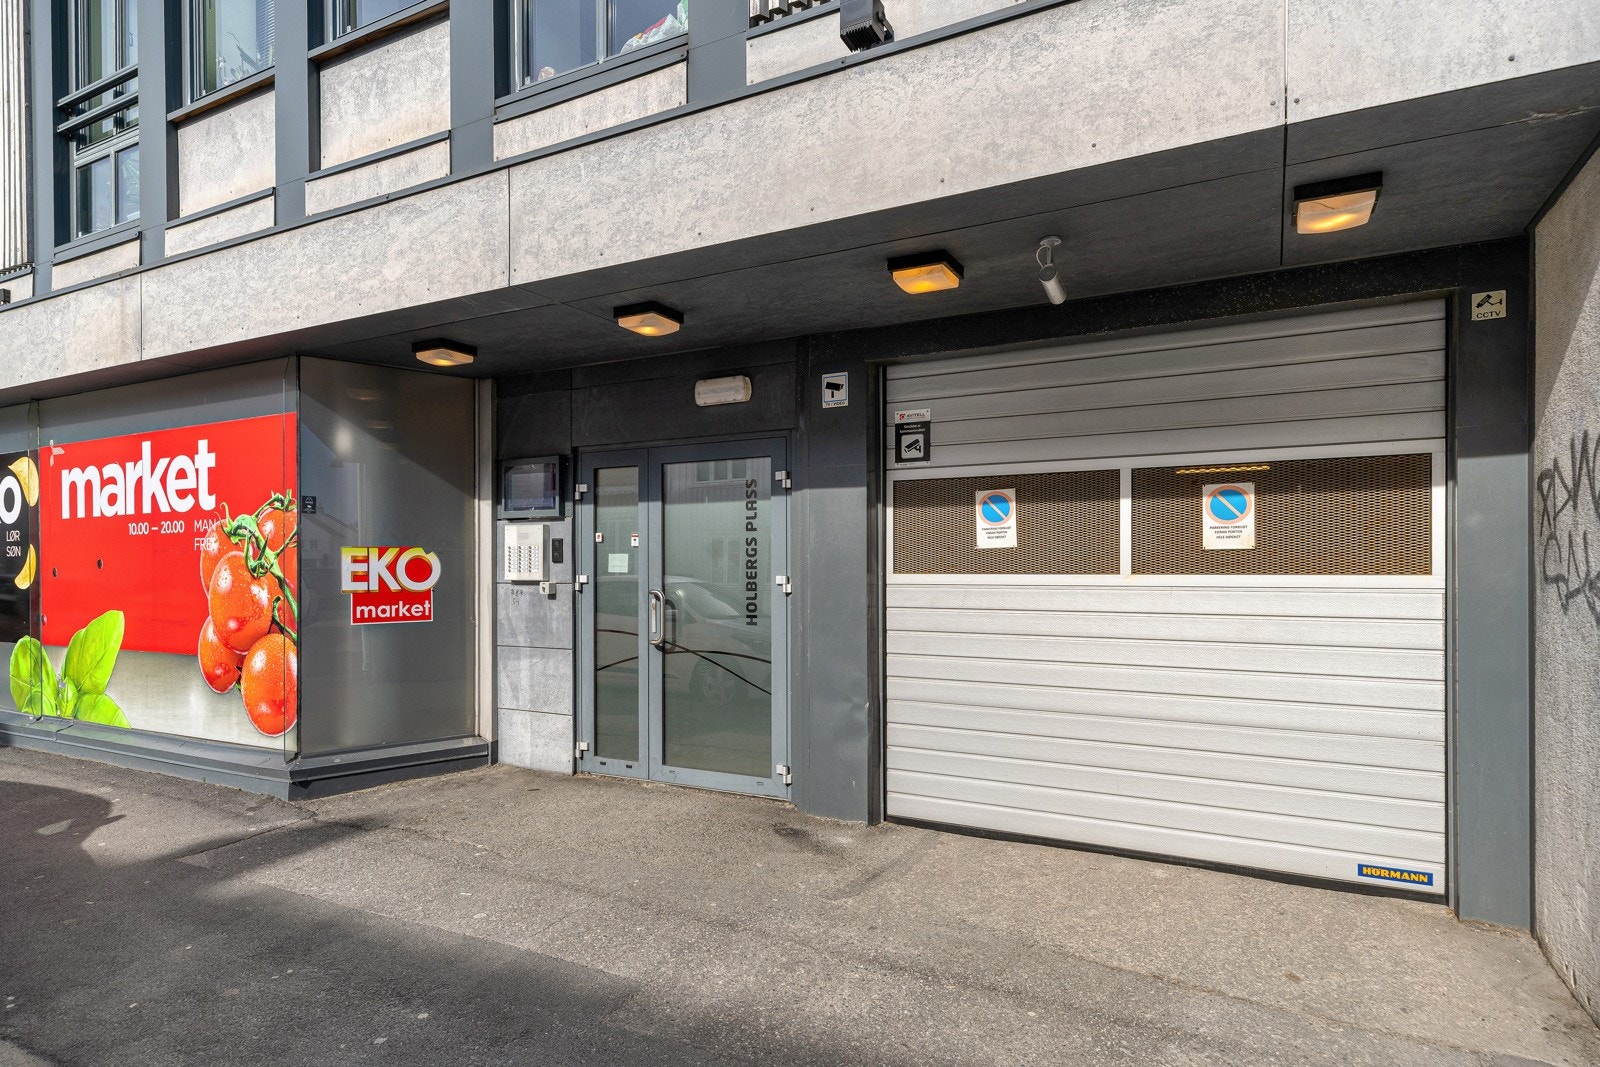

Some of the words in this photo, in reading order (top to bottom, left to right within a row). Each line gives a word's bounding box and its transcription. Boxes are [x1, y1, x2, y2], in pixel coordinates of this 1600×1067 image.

[0, 475, 22, 525] o
[61, 439, 216, 519] market
[128, 522, 149, 535] 10.00
[160, 520, 185, 534] 20.00
[194, 519, 216, 532] MAN
[745, 478, 758, 532] PLASS
[6, 530, 21, 542] LØR
[6, 546, 21, 557] SØN
[341, 547, 441, 594] EKO
[745, 536, 758, 626] HOLBERGS
[356, 600, 430, 618] market
